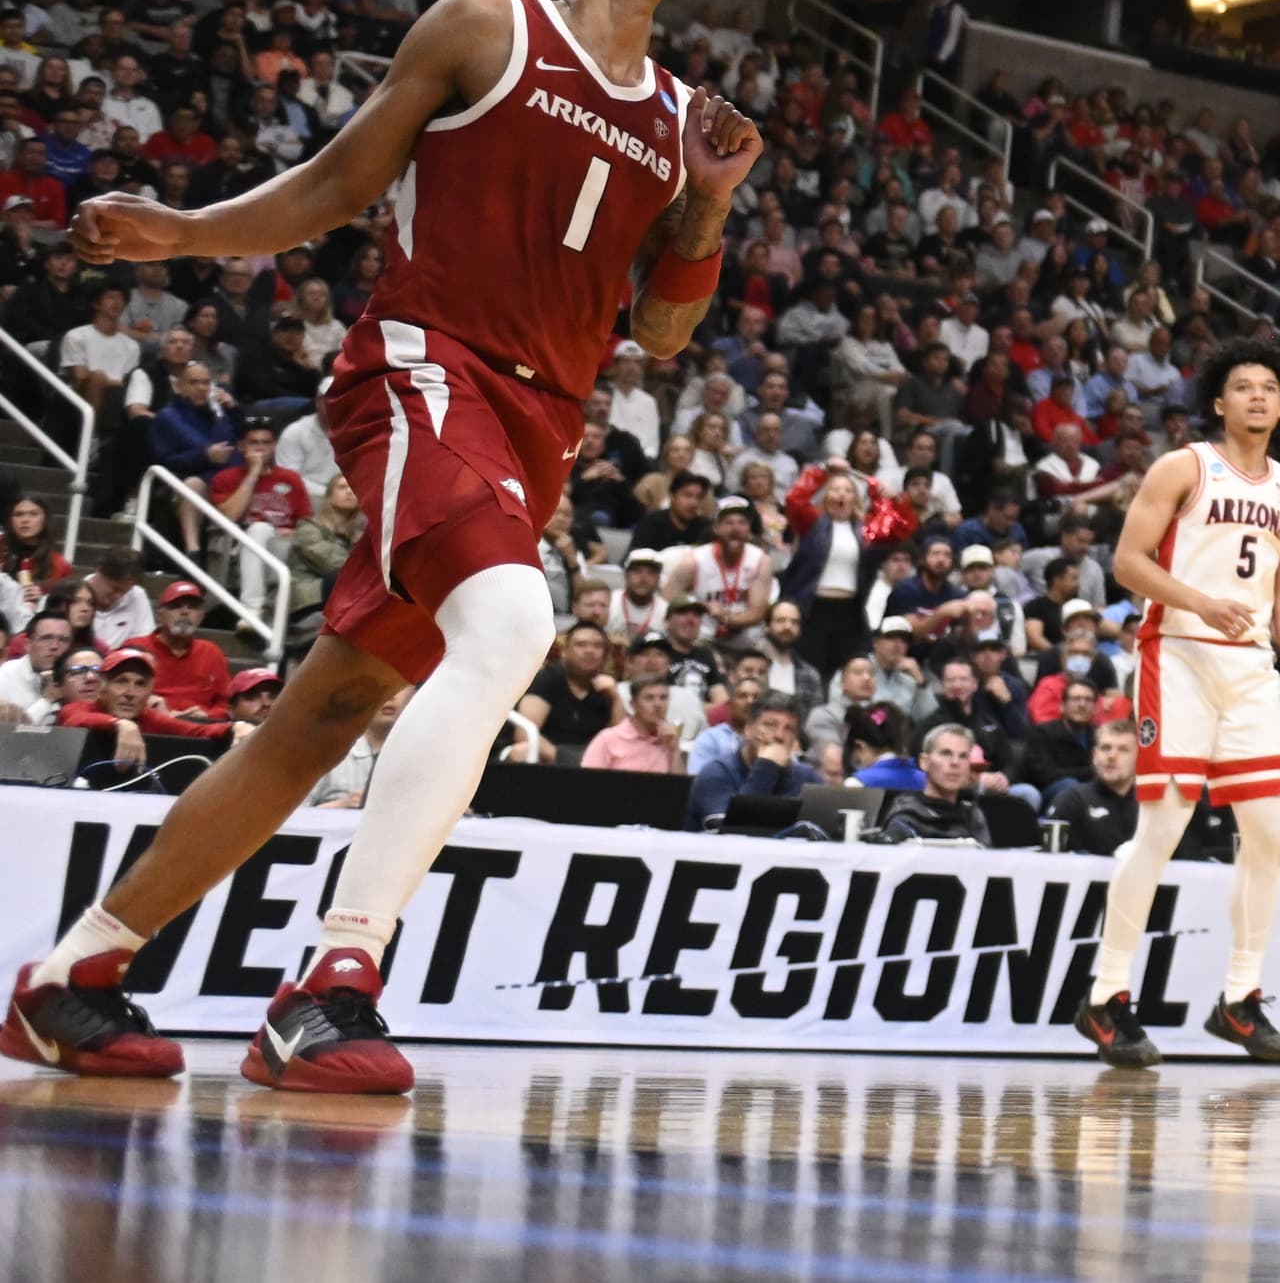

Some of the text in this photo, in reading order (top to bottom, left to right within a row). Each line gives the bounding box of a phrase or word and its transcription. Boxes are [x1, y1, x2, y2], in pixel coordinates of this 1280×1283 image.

[525, 87, 672, 182] ARKANSAS
[562, 155, 612, 252] 1
[1236, 535, 1257, 579] 5
